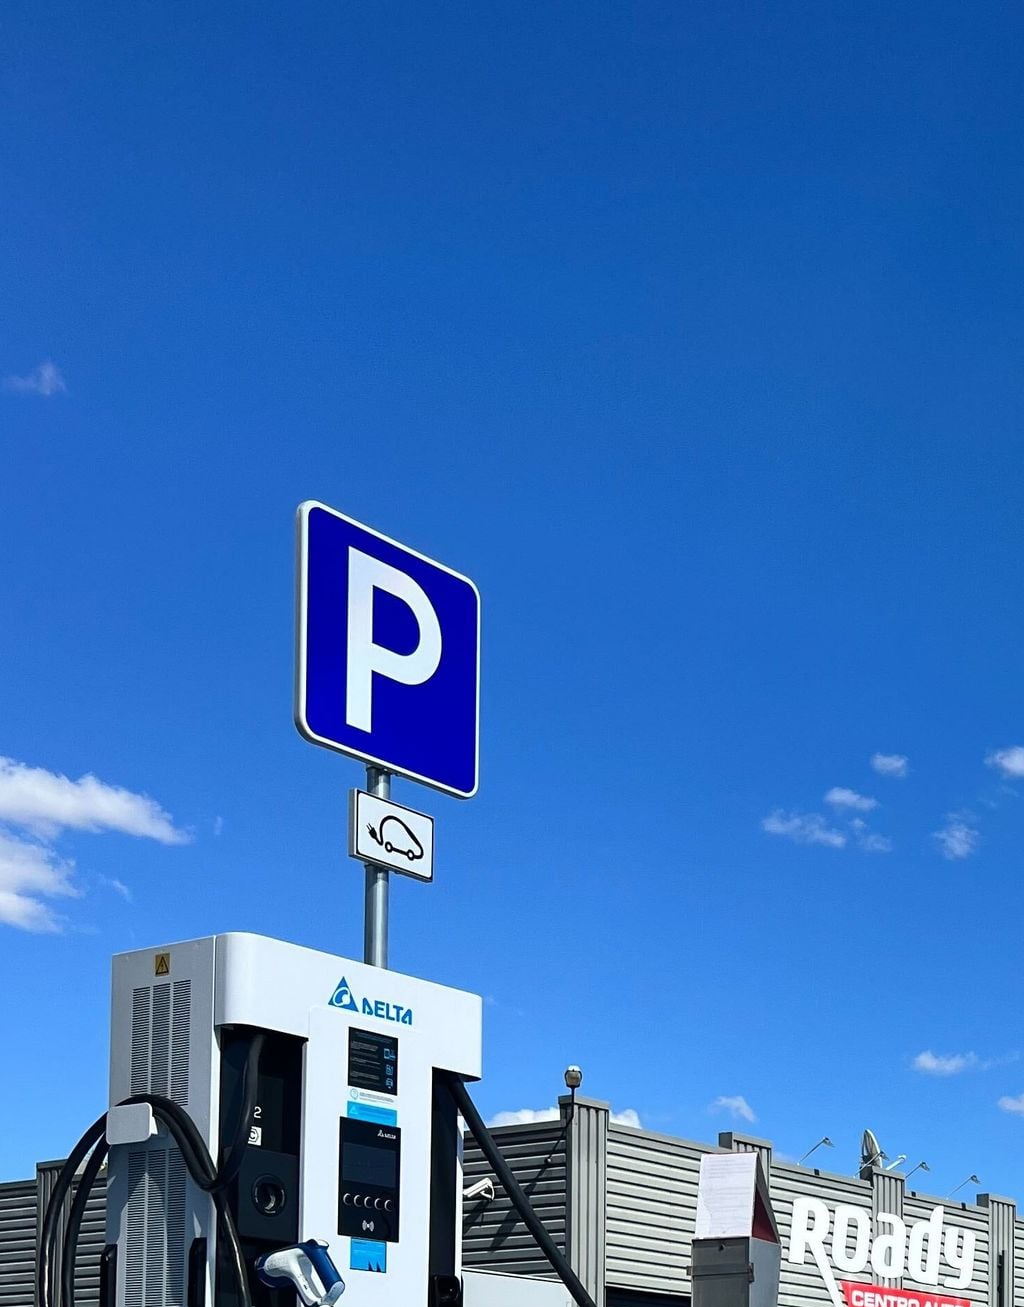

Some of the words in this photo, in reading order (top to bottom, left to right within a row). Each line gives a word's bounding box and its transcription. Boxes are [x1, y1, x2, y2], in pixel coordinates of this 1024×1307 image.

[346, 546, 442, 733] P
[362, 997, 413, 1026] DELTA
[253, 1105, 262, 1119] 2
